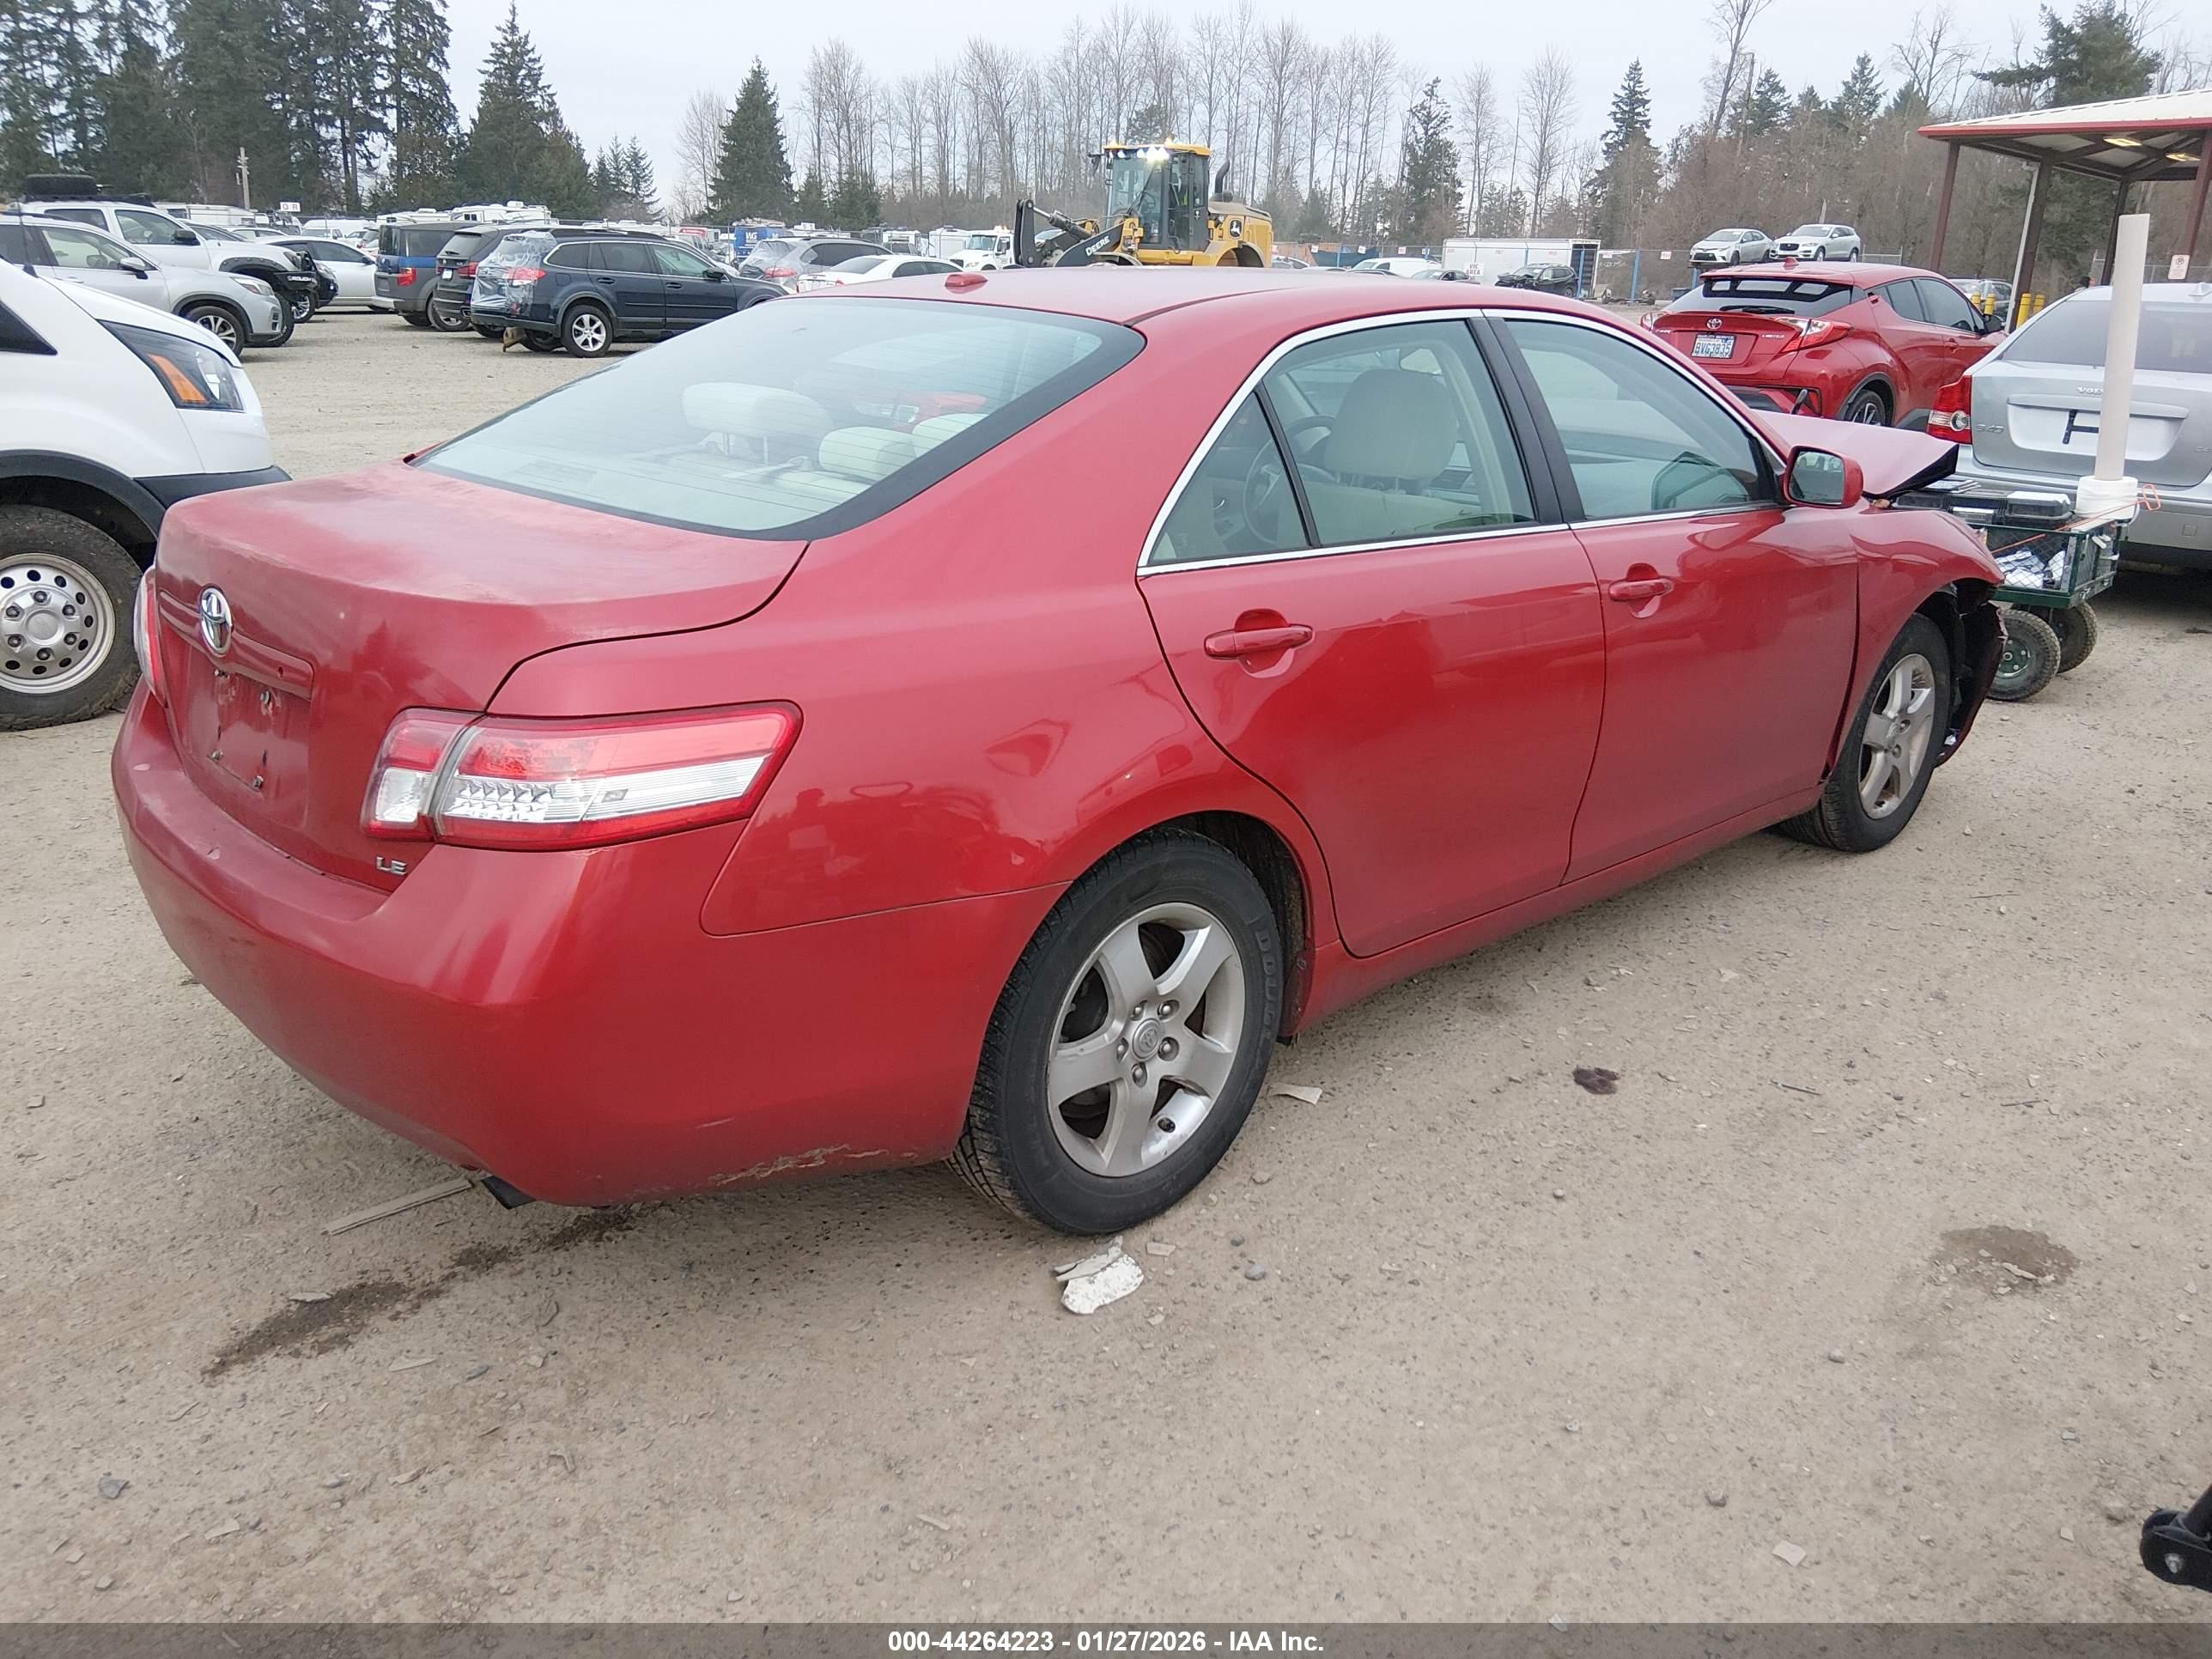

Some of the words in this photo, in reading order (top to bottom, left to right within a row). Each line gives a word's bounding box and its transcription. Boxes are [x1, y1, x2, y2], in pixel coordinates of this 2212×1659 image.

[1085, 235, 1110, 257] DEERE
[1694, 343, 1731, 355] BVG3835
[376, 856, 408, 876] LE
